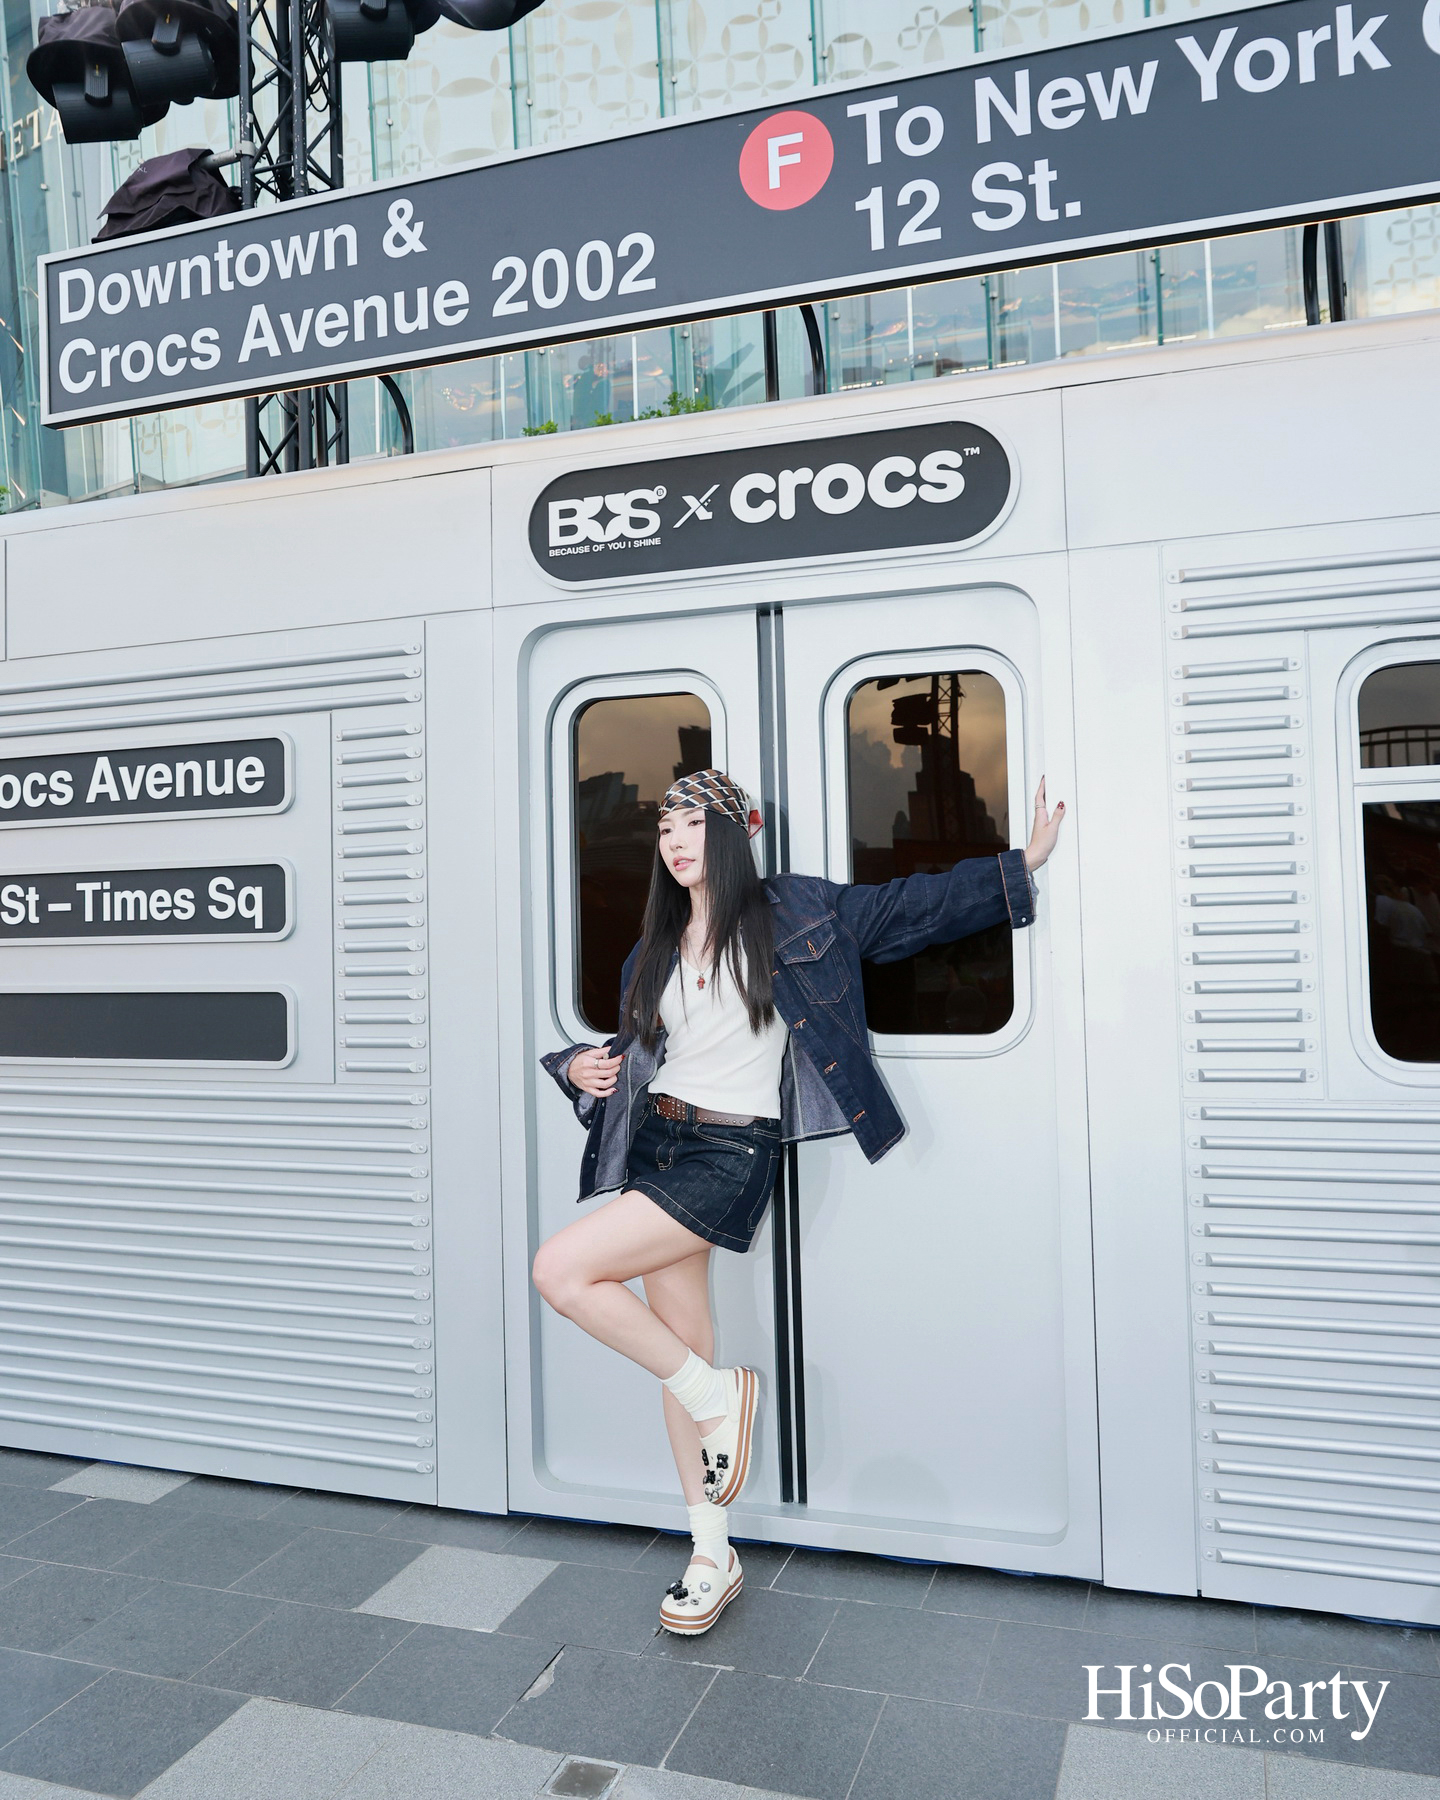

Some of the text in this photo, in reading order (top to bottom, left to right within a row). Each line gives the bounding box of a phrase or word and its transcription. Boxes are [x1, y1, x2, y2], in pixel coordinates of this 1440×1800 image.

[846, 95, 944, 165] To
[974, 59, 1158, 144] New
[1175, 4, 1392, 103] York
[767, 131, 804, 190] F
[854, 158, 1082, 252] 12 St.
[58, 198, 428, 325] Downtown &
[58, 231, 657, 394] Crocs Avenue 2002
[549, 545, 591, 557] BECAUSE
[592, 543, 605, 552] OF
[607, 541, 626, 550] YOU
[633, 537, 662, 548] SHINE
[85, 756, 266, 804] Avenue
[0, 884, 40, 925] St
[207, 876, 263, 929] Sq
